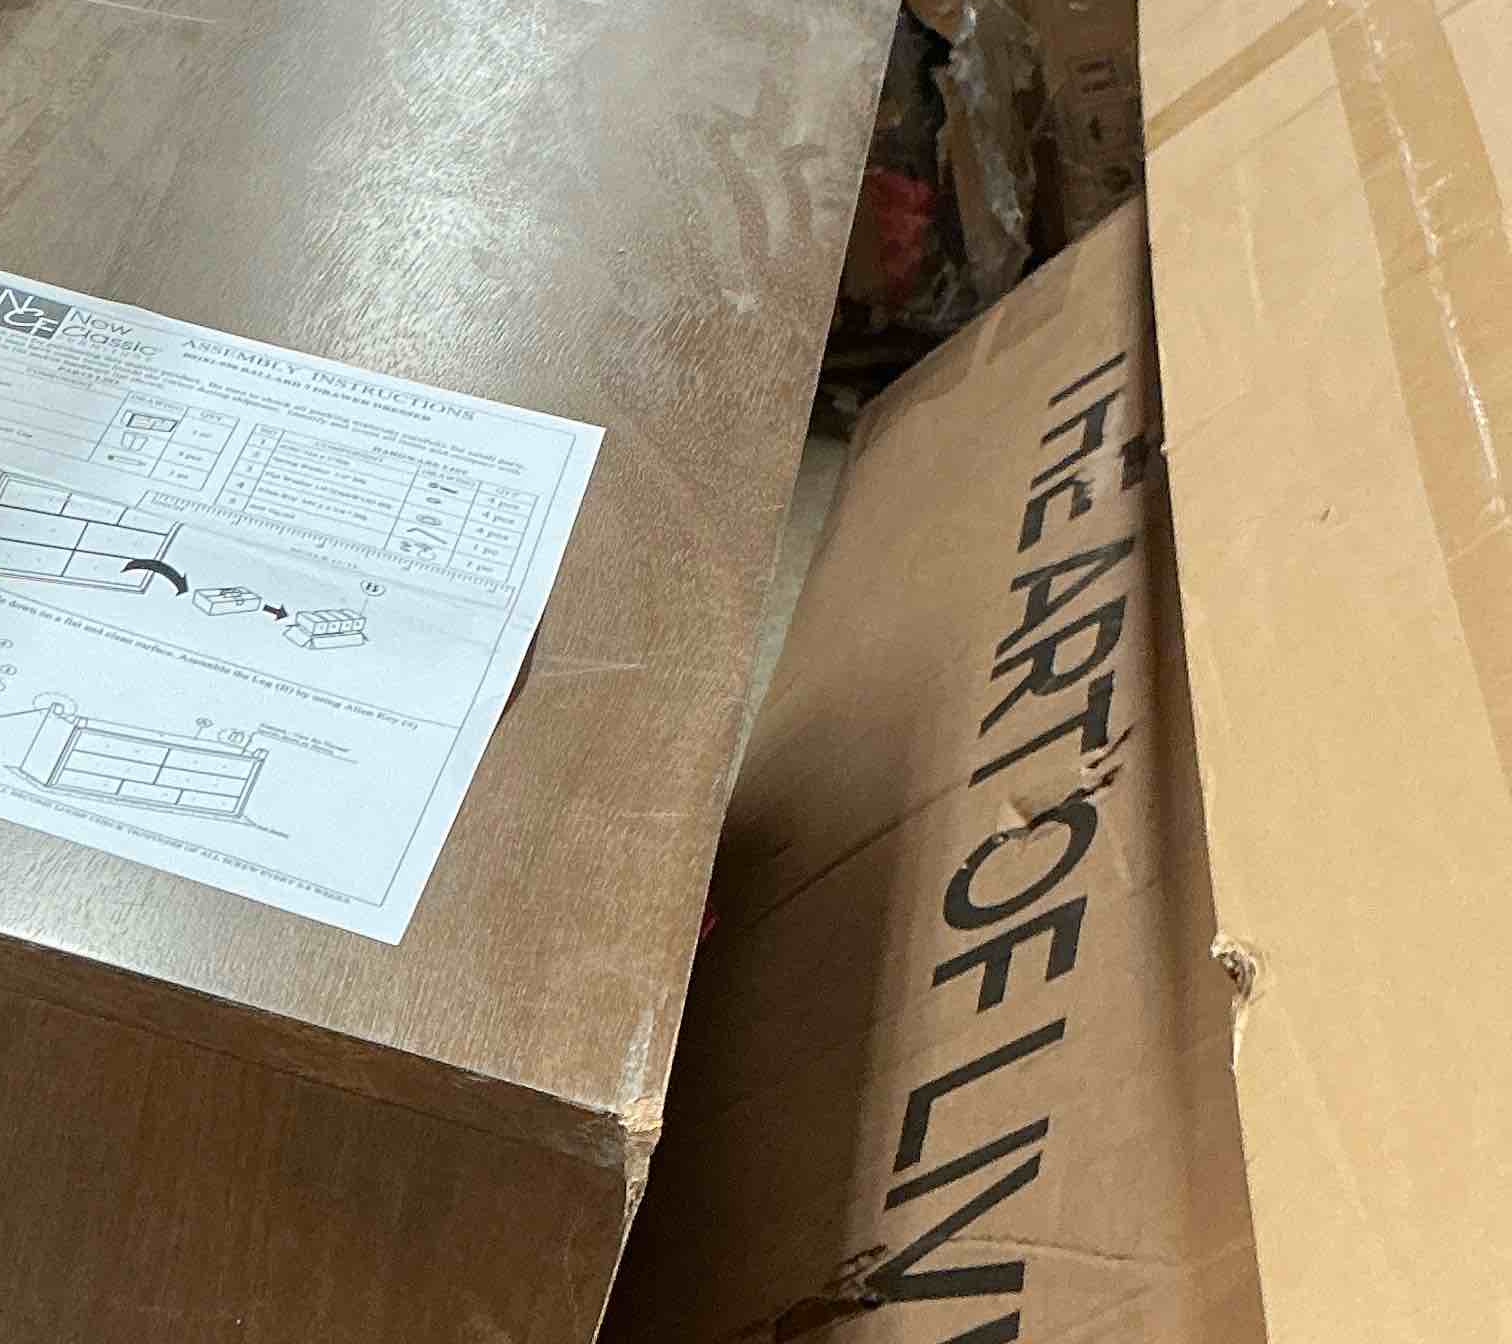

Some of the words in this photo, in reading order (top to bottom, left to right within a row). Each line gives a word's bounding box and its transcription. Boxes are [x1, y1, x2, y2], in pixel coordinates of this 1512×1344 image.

[181, 339, 296, 375] ASSEMBLY
[311, 371, 475, 421] INSTRUCTIONS
[968, 534, 1137, 788] ART
[930, 793, 1102, 1013] OF
